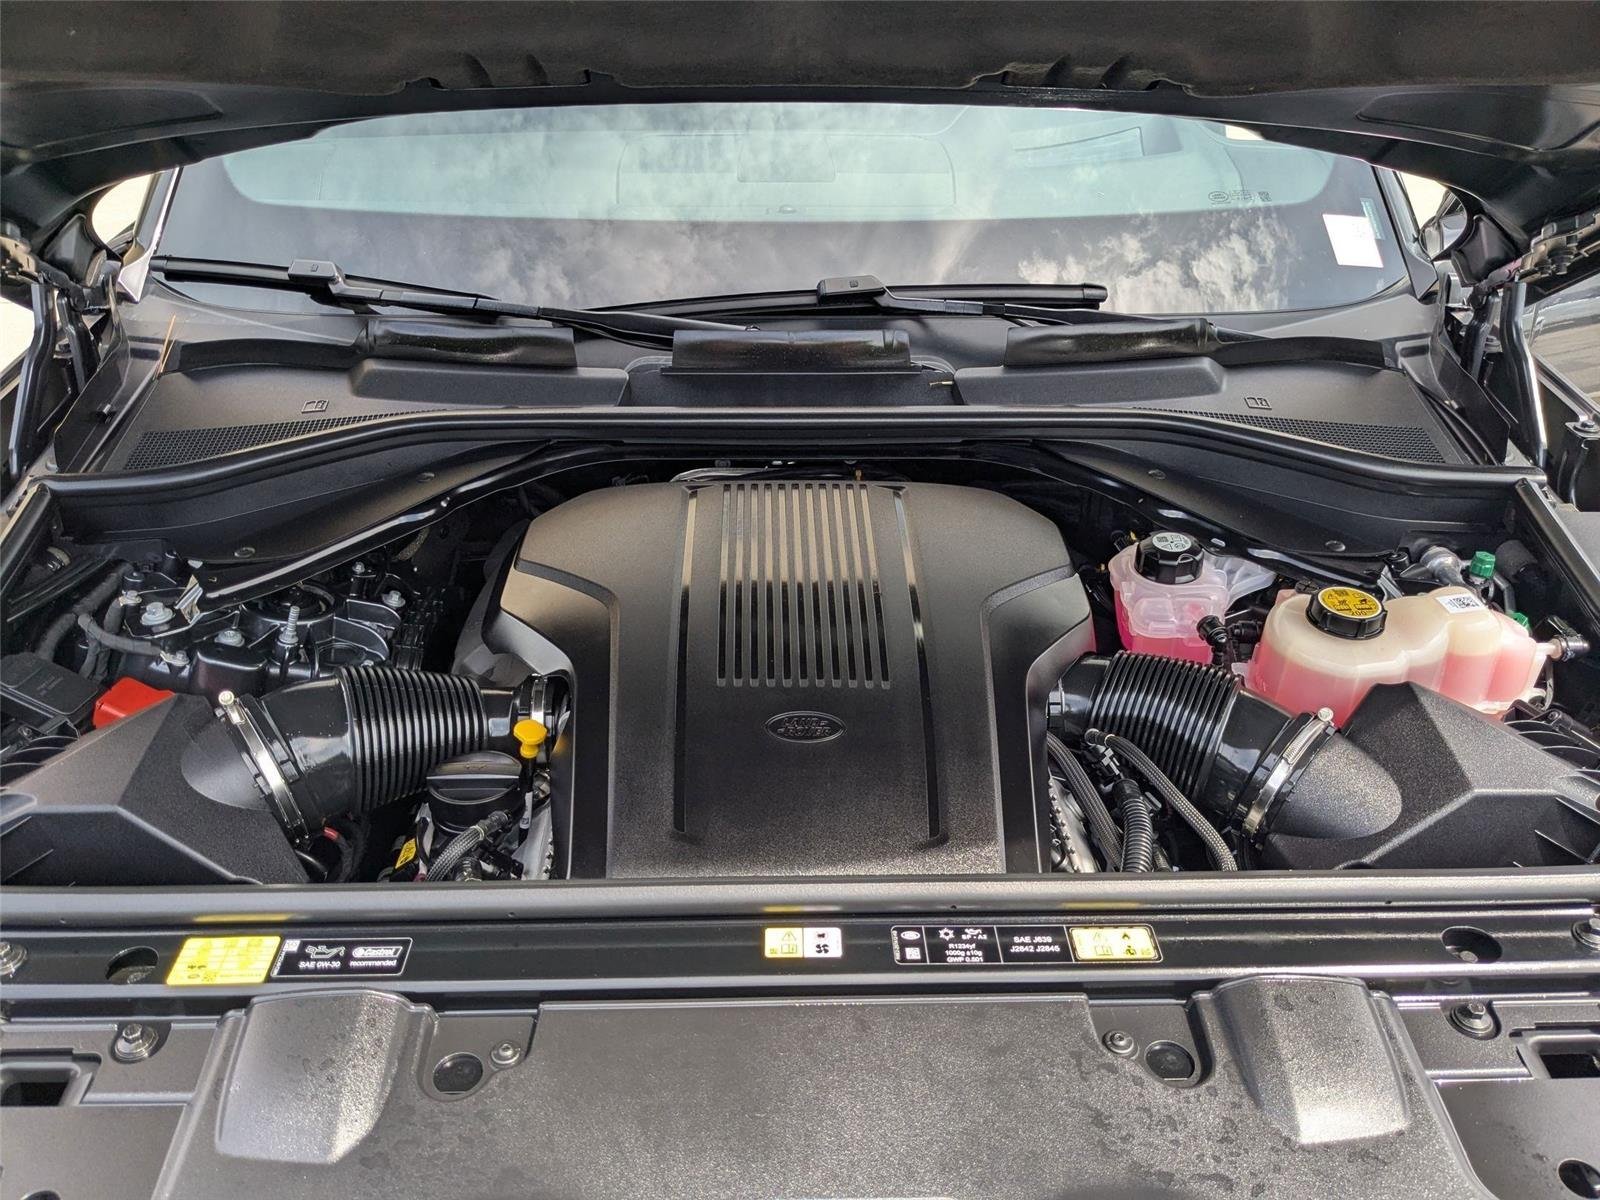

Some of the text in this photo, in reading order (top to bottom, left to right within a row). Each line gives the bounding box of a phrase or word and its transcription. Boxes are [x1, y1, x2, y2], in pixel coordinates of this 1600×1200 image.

[364, 948, 396, 958] Castrol
[299, 961, 341, 969] SAE 0W-30
[349, 959, 397, 967] recommended
